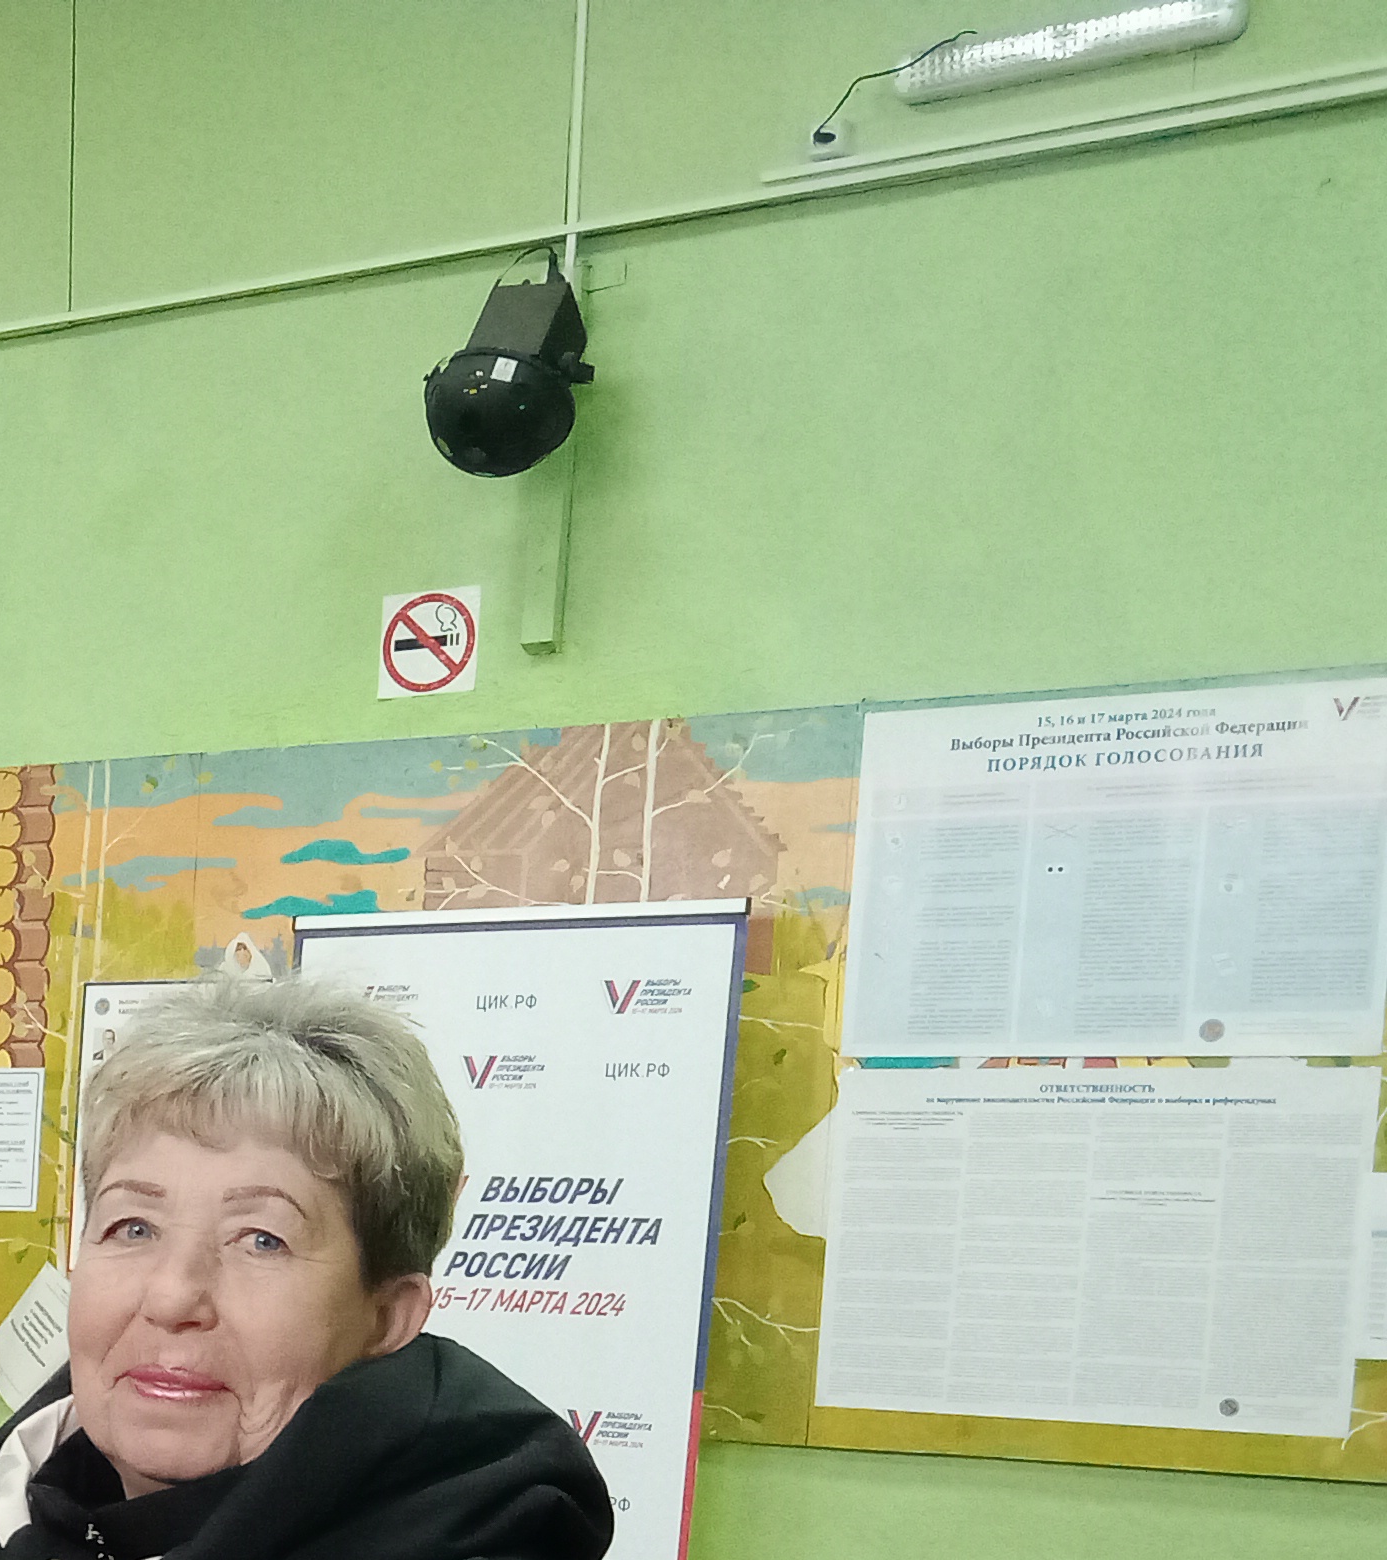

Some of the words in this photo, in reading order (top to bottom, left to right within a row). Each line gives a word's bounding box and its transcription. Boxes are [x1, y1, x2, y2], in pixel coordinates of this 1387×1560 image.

[1037, 715, 1056, 729] 15,
[1060, 714, 1075, 727] 16
[1090, 712, 1106, 725] 17
[1107, 711, 1149, 725] марта
[1151, 707, 1183, 721] 2024
[949, 736, 1015, 753] Выборы
[1018, 730, 1112, 750] Президента
[1115, 722, 1210, 741] Российской
[1214, 719, 1310, 736] Федерации
[986, 752, 1088, 772] ПОРЯДОК
[1095, 742, 1264, 767] ГОЛОСОВАНИЯ
[480, 1175, 625, 1205] ВЫБОРЫ
[462, 1213, 663, 1247] ПРЕЗИДЕНТА
[443, 1251, 573, 1281] РОССИИ
[490, 1288, 569, 1315] МАРТА
[569, 1292, 627, 1317] 2024
